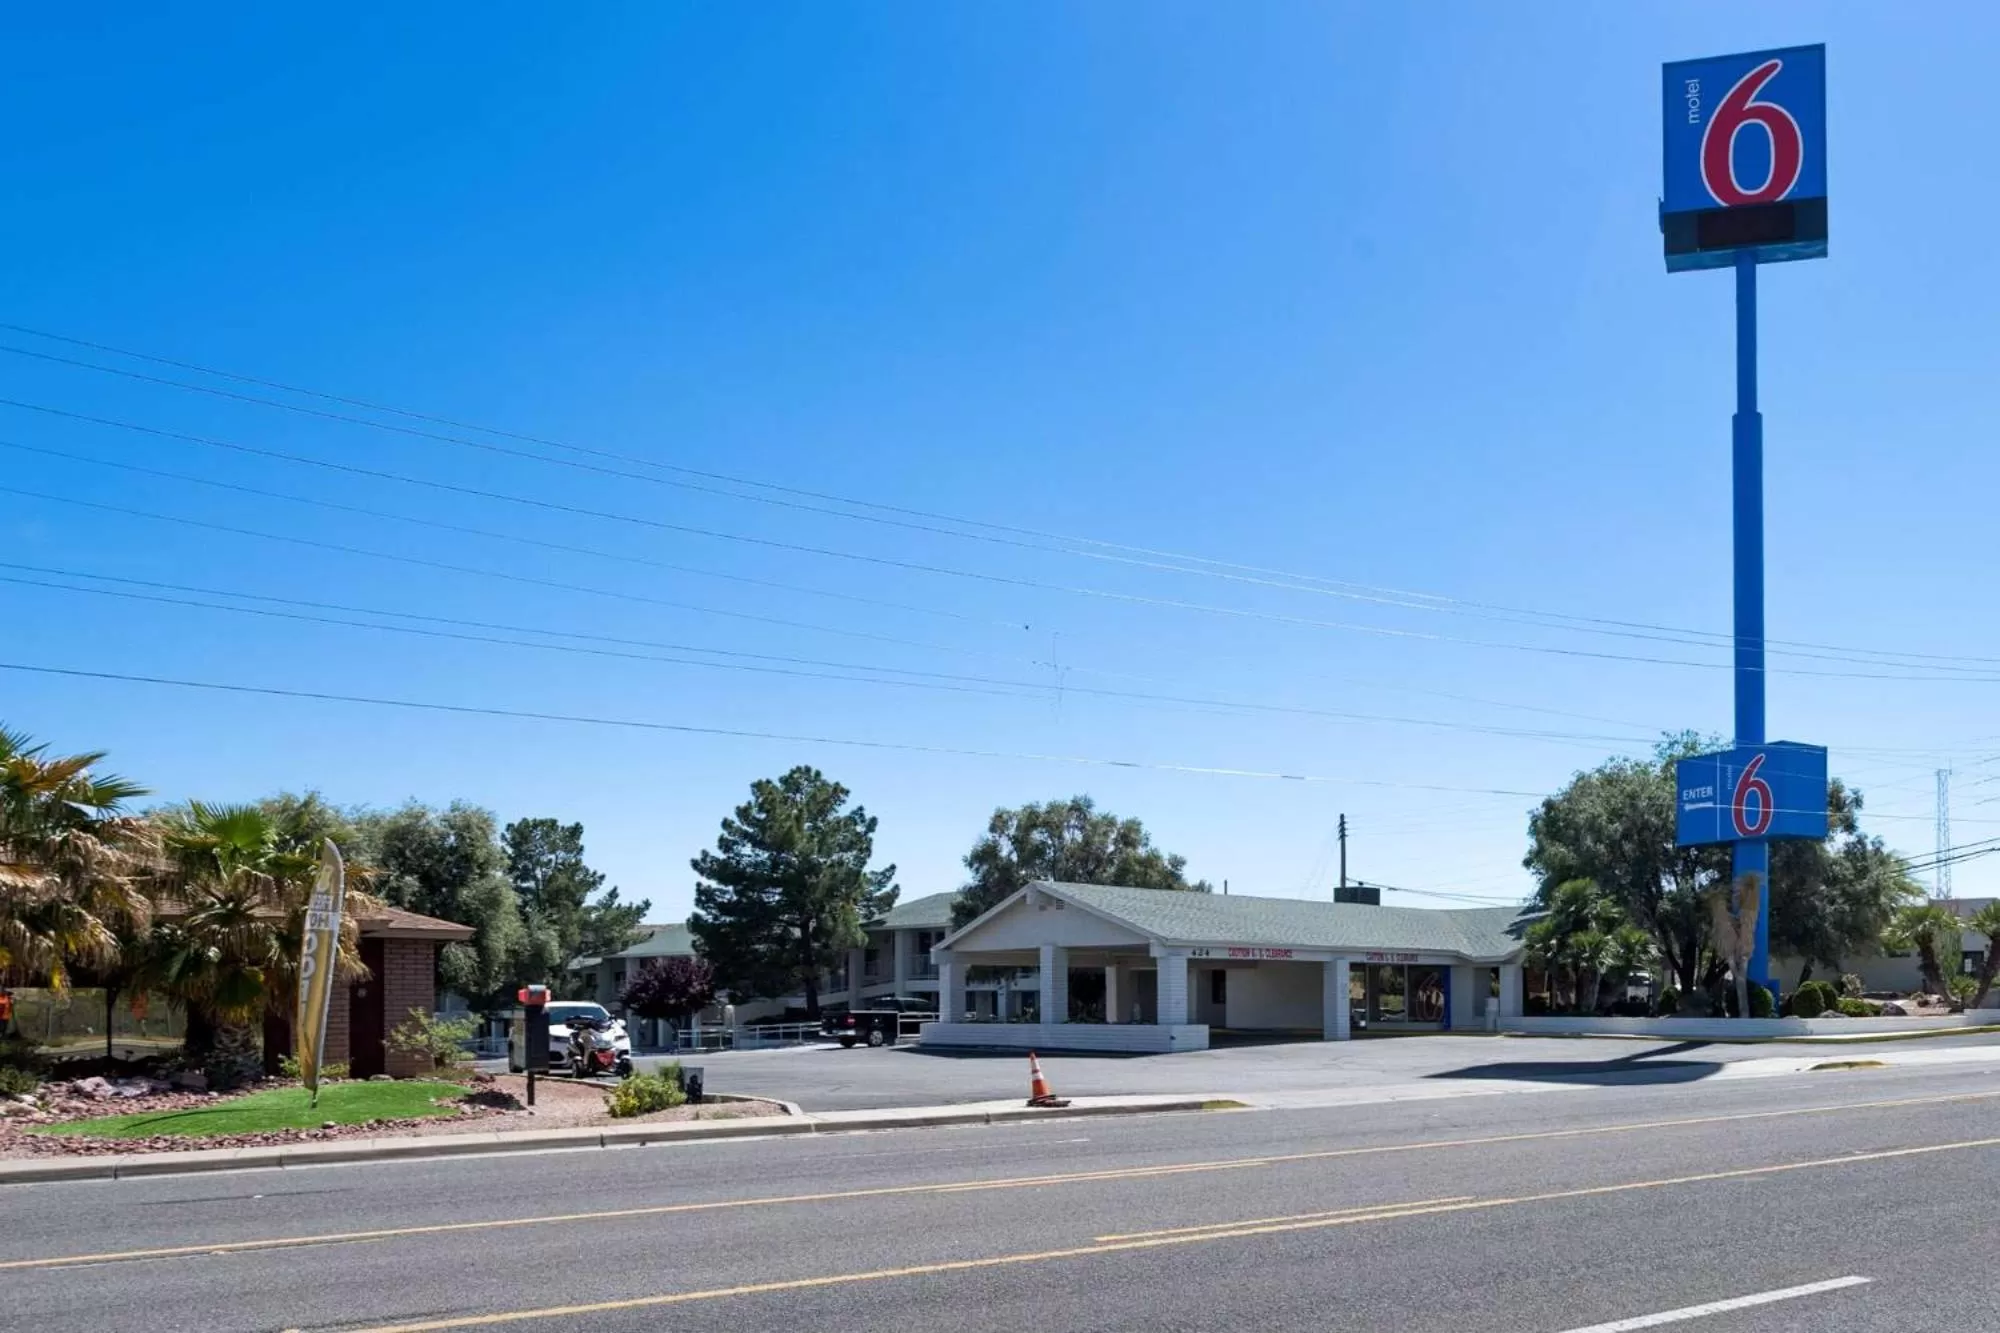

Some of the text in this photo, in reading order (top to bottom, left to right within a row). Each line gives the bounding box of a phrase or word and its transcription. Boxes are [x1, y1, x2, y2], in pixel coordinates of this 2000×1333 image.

[1684, 58, 1804, 207] motel 6
[1682, 785, 1714, 801] ENTER
[1732, 752, 1774, 837] 6
